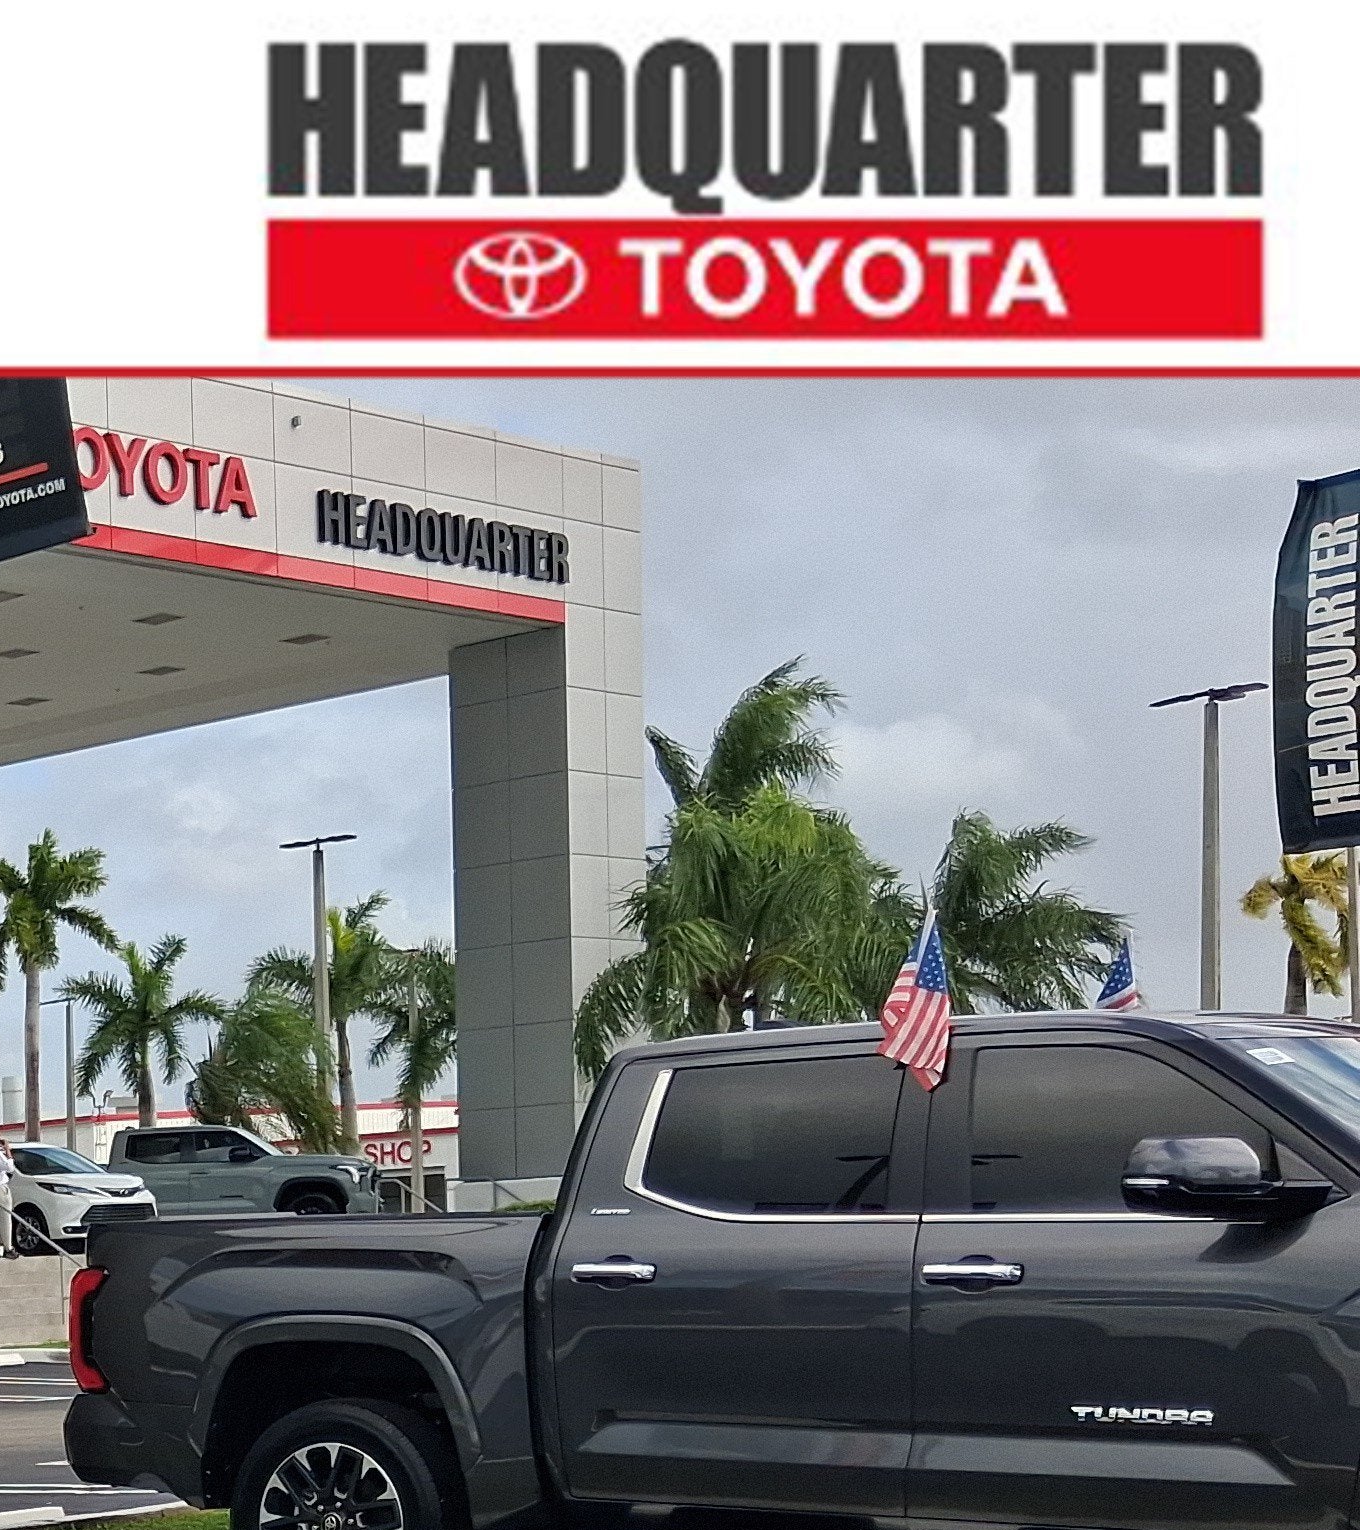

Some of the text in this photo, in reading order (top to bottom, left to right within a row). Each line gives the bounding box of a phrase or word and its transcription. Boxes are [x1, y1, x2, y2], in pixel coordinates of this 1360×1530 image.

[318, 488, 570, 583] HEADQUARTER
[1306, 513, 1360, 817] HEADQUARTER
[1070, 1406, 1215, 1426] TUNDRA
